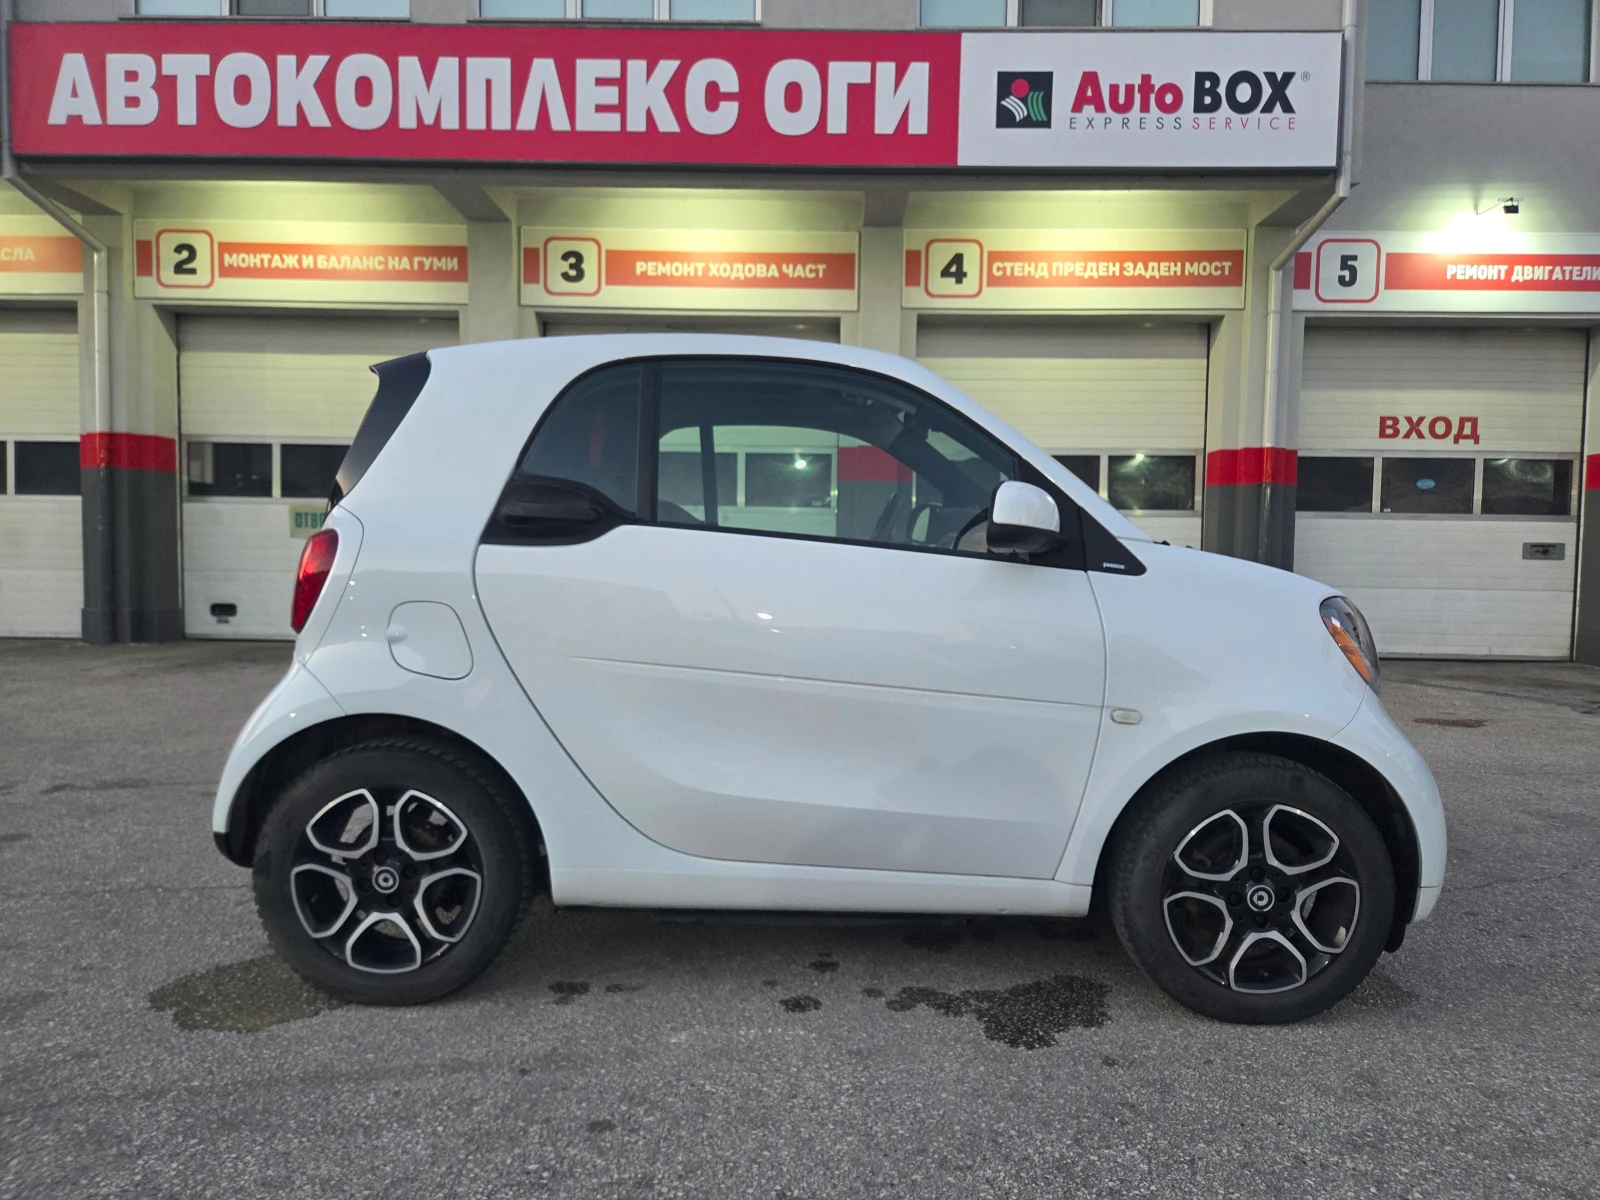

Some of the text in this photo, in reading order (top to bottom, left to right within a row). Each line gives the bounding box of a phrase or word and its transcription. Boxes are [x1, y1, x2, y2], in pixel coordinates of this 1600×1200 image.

[47, 52, 929, 136] АВТОКОМПЛЕКС ОГИ
[1070, 70, 1296, 115] Auto BOX
[1069, 117, 1296, 130] EXPRESS SERVICE
[173, 243, 197, 275] 2
[223, 252, 459, 272] МОНТАЖ И БАЛАНС НА ГУМИ
[560, 250, 585, 283] 3
[635, 261, 827, 280] РЕМОНТ ХОДОВА ЧАСТ
[940, 253, 967, 284] 4
[992, 261, 1233, 279] СТЕНД ПРЕДЕН ЗАДЕН МОСТ
[1337, 254, 1359, 287] 5
[1446, 264, 1600, 283] РЕМОНТ ДВИГАТЕЛИ
[1378, 415, 1480, 445] ВХОД
